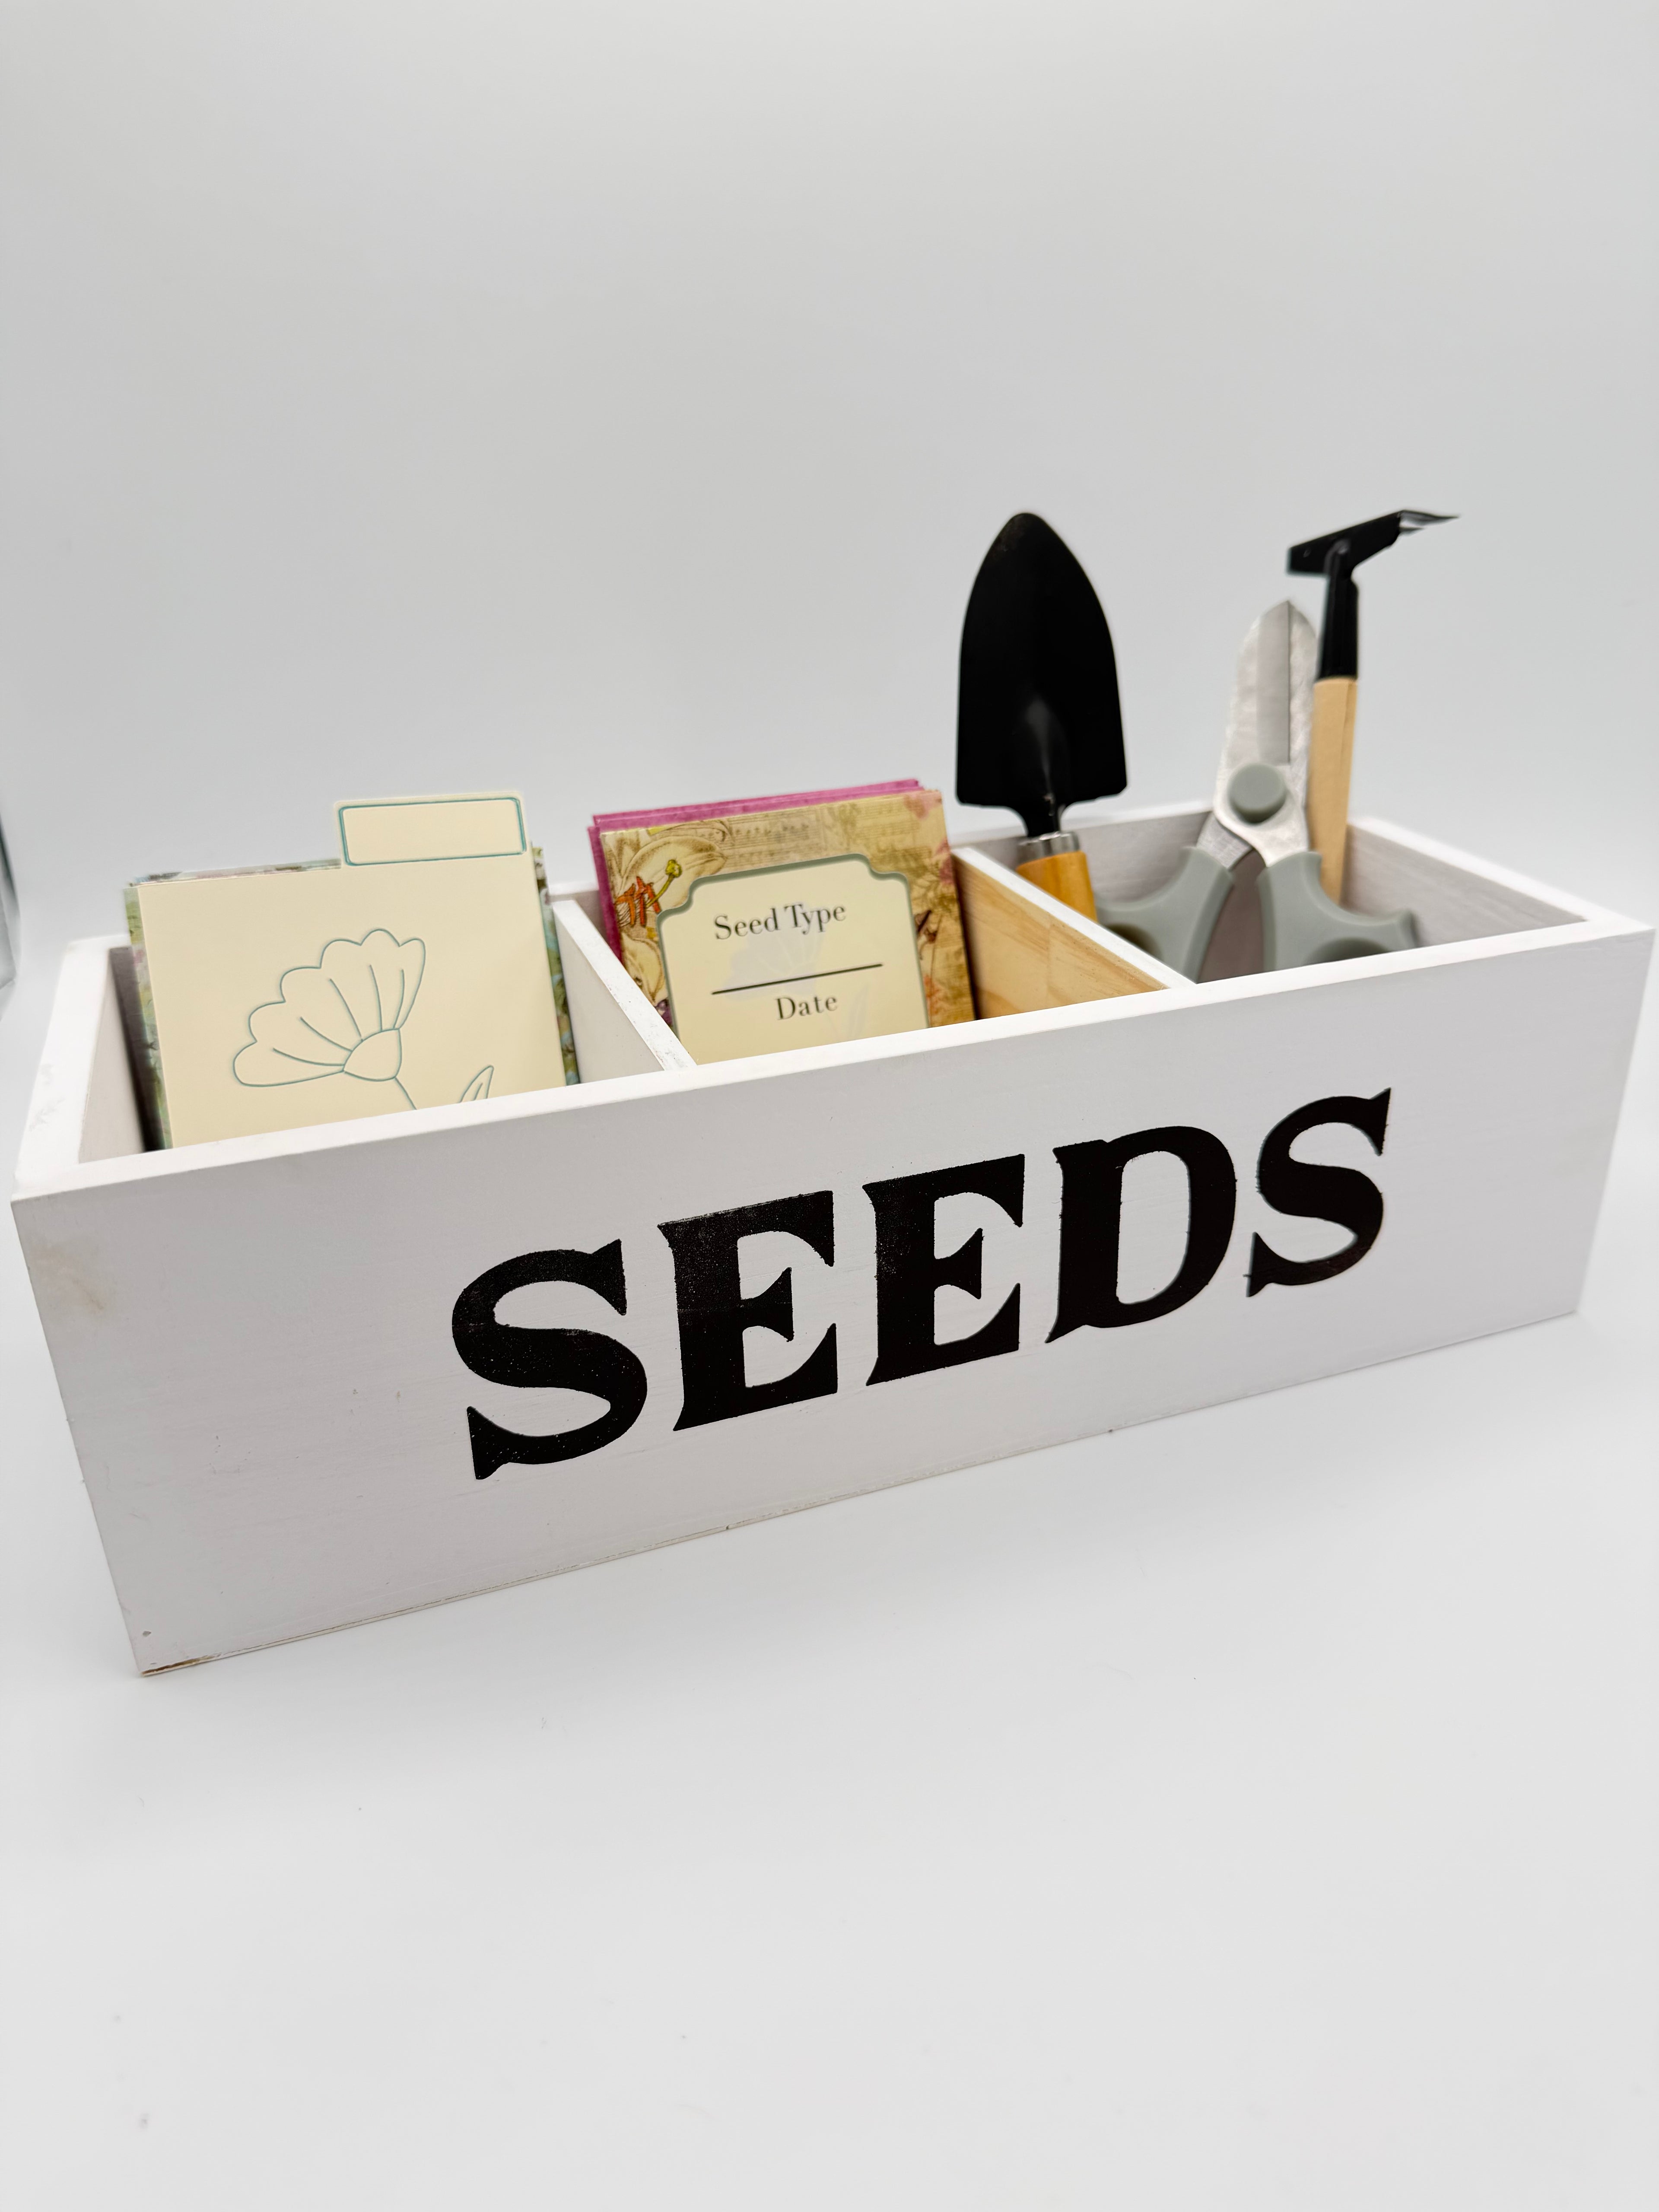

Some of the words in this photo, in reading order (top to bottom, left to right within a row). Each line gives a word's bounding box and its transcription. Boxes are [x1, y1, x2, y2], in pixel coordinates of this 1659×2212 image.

[714, 906, 780, 940] Seed
[784, 903, 846, 935] Type
[775, 995, 838, 1020] Date
[451, 1087, 1392, 1481] SEEDS
